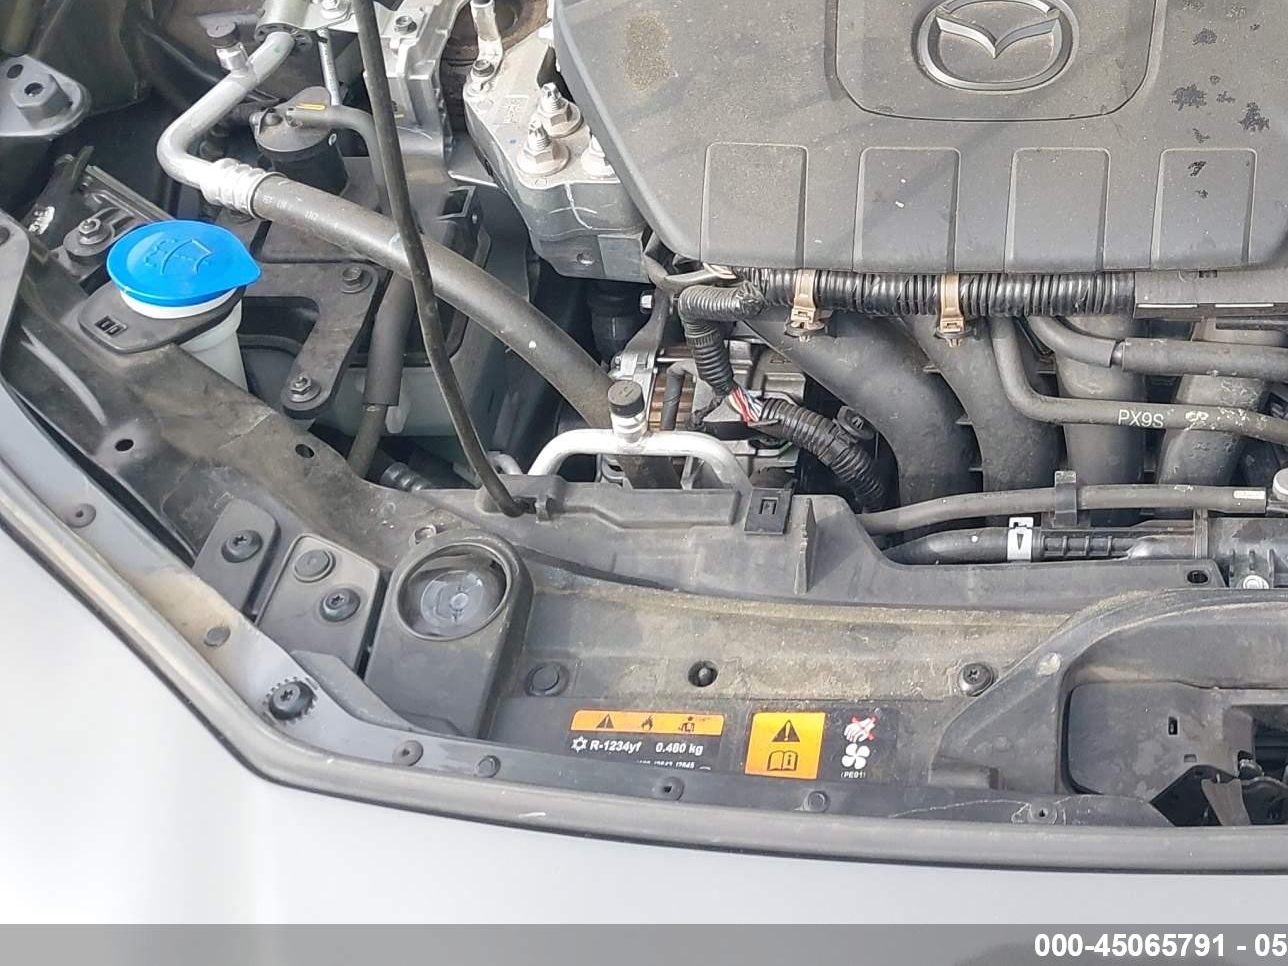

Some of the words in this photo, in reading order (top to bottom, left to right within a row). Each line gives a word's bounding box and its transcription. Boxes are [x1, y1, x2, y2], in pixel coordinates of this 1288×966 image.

[1118, 409, 1164, 428] PX9S
[589, 739, 642, 754] R-1234yf
[688, 743, 704, 756] kg
